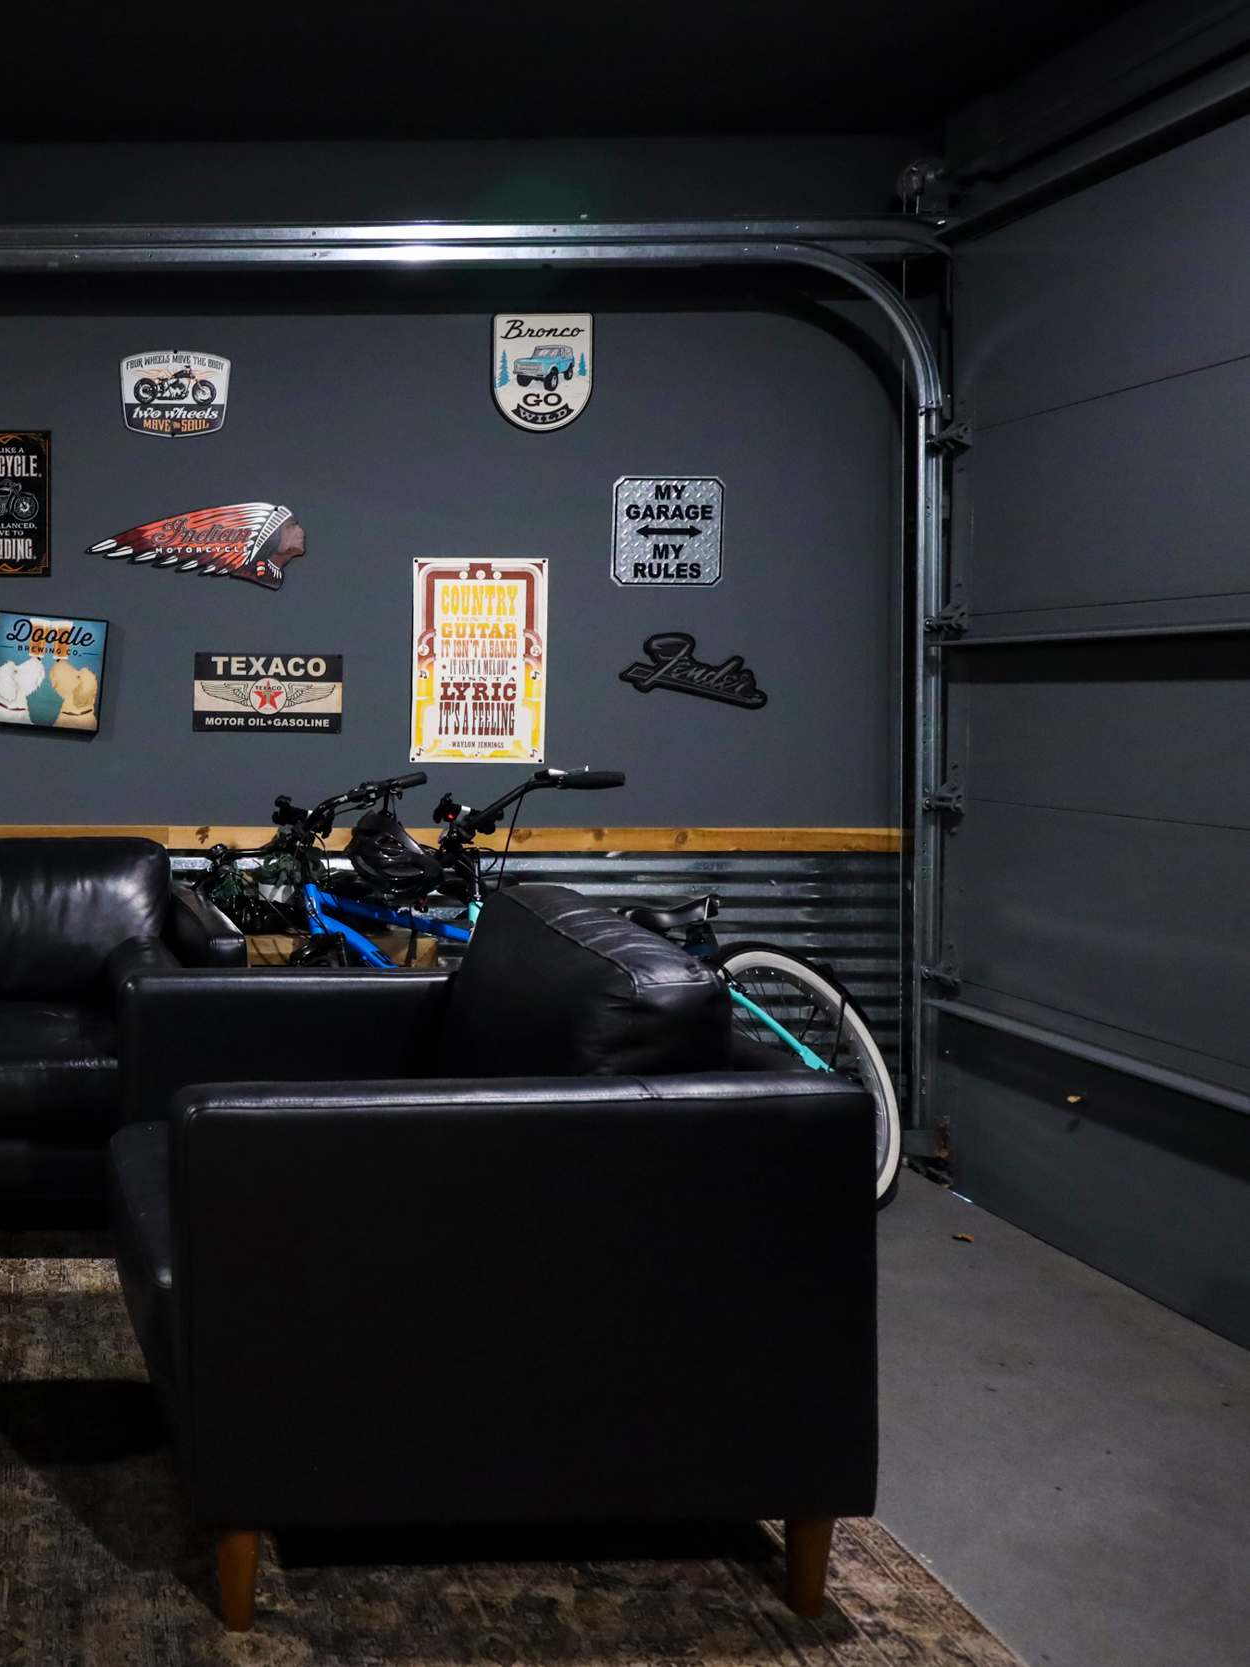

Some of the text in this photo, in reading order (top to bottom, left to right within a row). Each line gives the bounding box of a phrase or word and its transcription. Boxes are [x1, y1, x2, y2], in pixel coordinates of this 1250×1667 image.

[500, 320, 585, 339] Bronco
[144, 355, 170, 366] WHEELS
[172, 355, 191, 364] MOVE
[193, 356, 207, 366] THE
[522, 392, 562, 406] GO
[132, 406, 219, 419] two wheels
[518, 408, 568, 423] WILD
[142, 419, 171, 431] MOVE
[654, 484, 686, 500] MY
[625, 504, 714, 520] GARAGE
[151, 518, 252, 547] Indian
[652, 544, 684, 559] MY
[633, 563, 701, 579] RULES
[441, 584, 518, 616] COUNTRY
[6, 619, 95, 646] Doodle
[441, 622, 516, 638] GUITAR
[17, 645, 62, 655] BREWING
[441, 640, 517, 658] IT ISN'T A BANJO
[211, 656, 326, 677] TEXACO
[450, 659, 456, 675] IT
[478, 659, 481, 675] A
[483, 659, 508, 675] MELODY
[628, 638, 763, 702] Fender
[440, 682, 516, 701] LYRIC
[205, 717, 330, 727] MOTOR OIL GASOLINE
[439, 702, 515, 736] IT'S A FEELING
